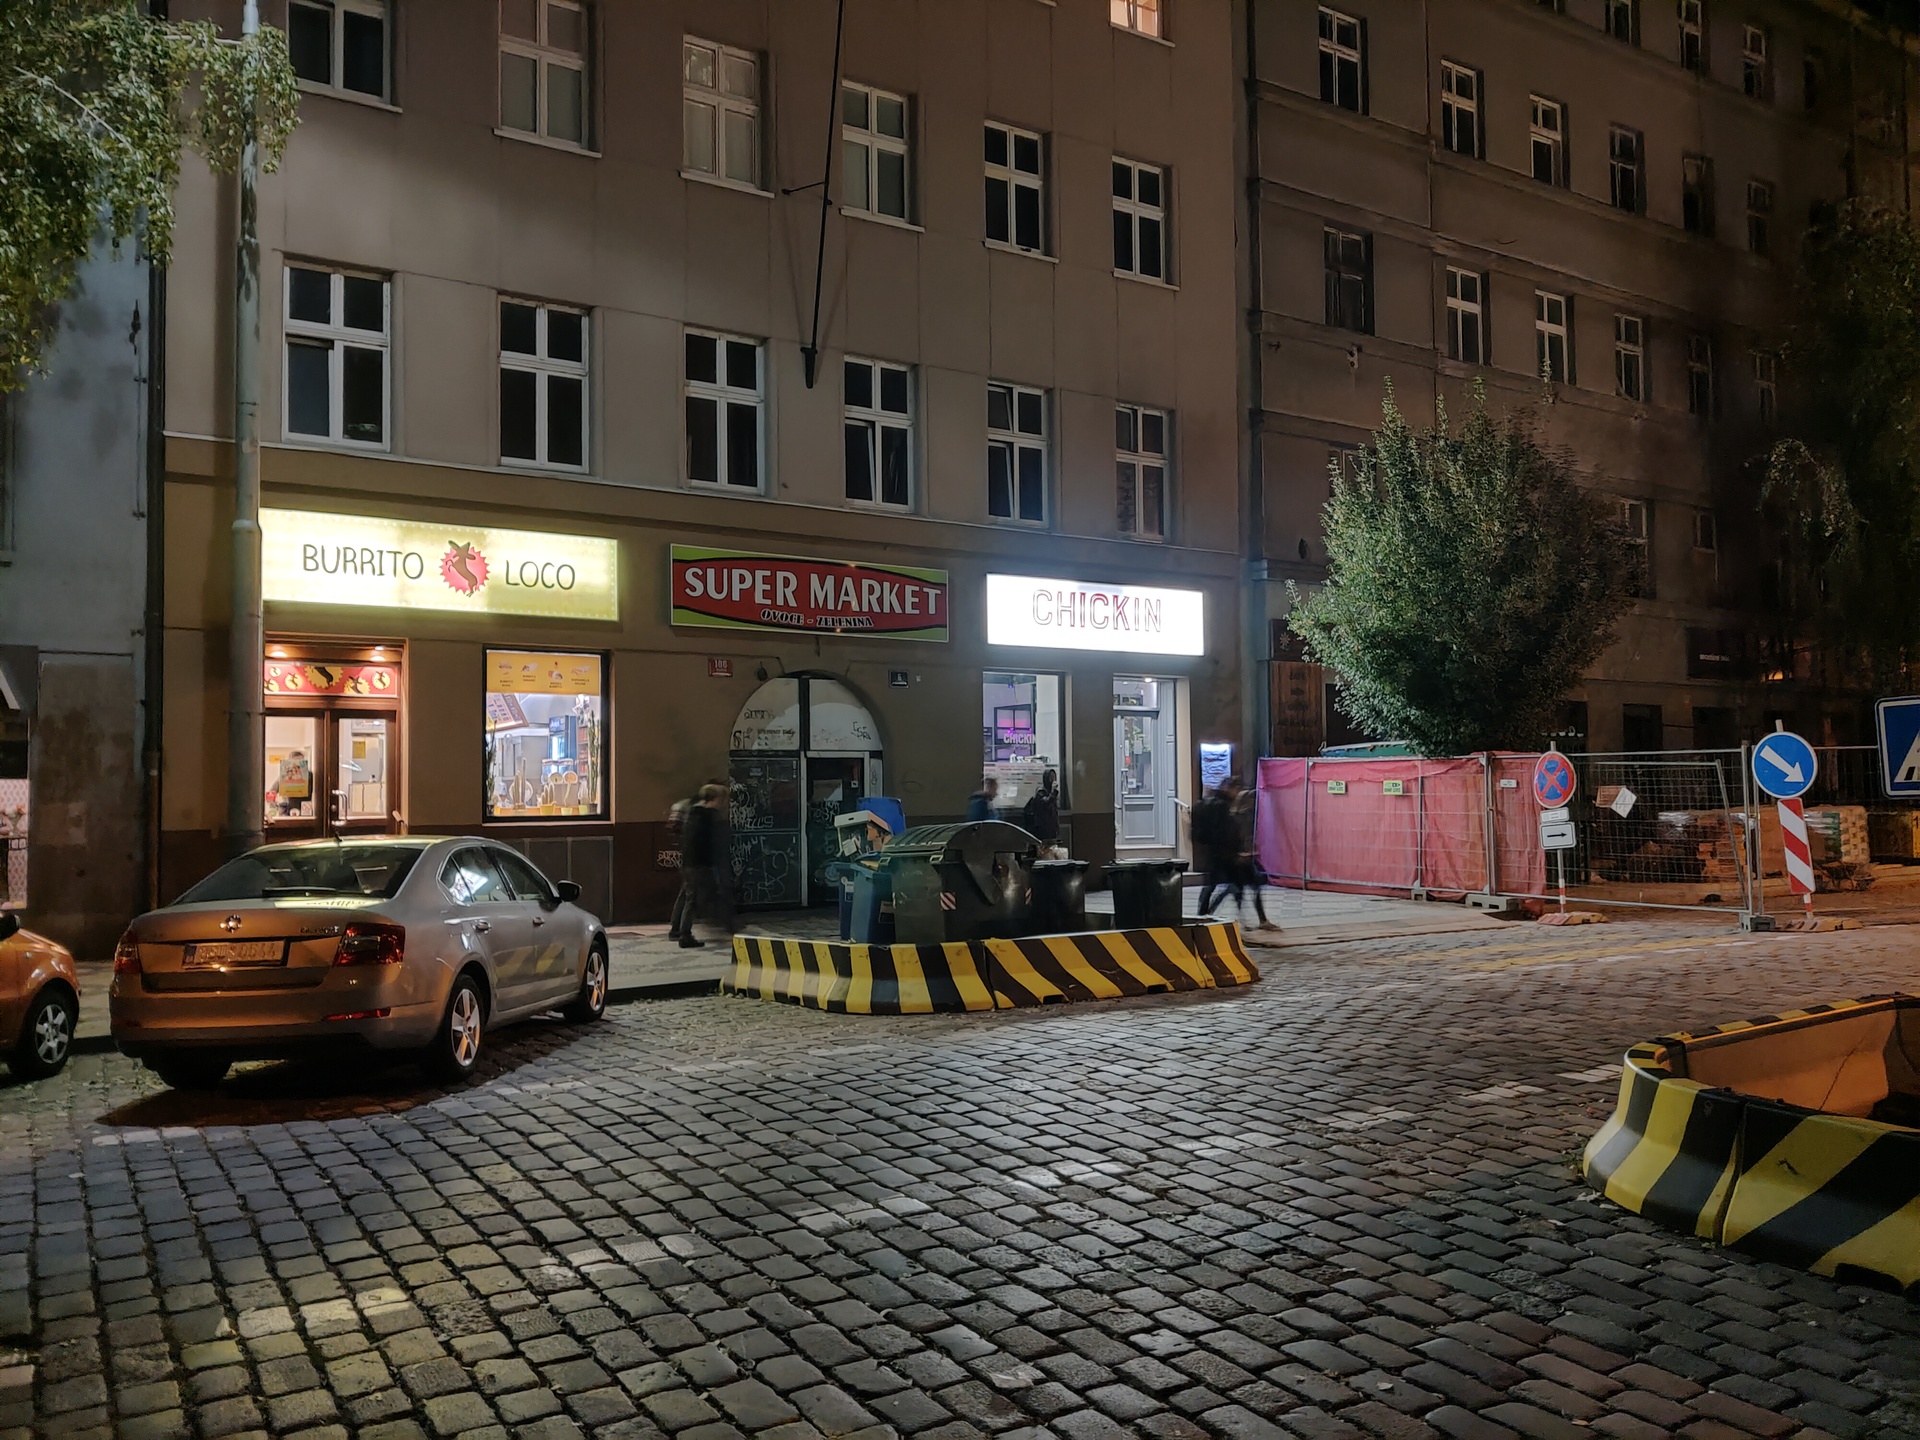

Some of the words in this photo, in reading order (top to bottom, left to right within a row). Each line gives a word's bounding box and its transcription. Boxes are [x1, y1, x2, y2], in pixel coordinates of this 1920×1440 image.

[302, 543, 424, 580] BURRITO
[504, 559, 576, 591] LOCO
[684, 566, 798, 608] SUPER
[809, 573, 942, 615] MARKET
[1032, 589, 1161, 633] CHICKIN
[816, 615, 874, 628] ZELENINA
